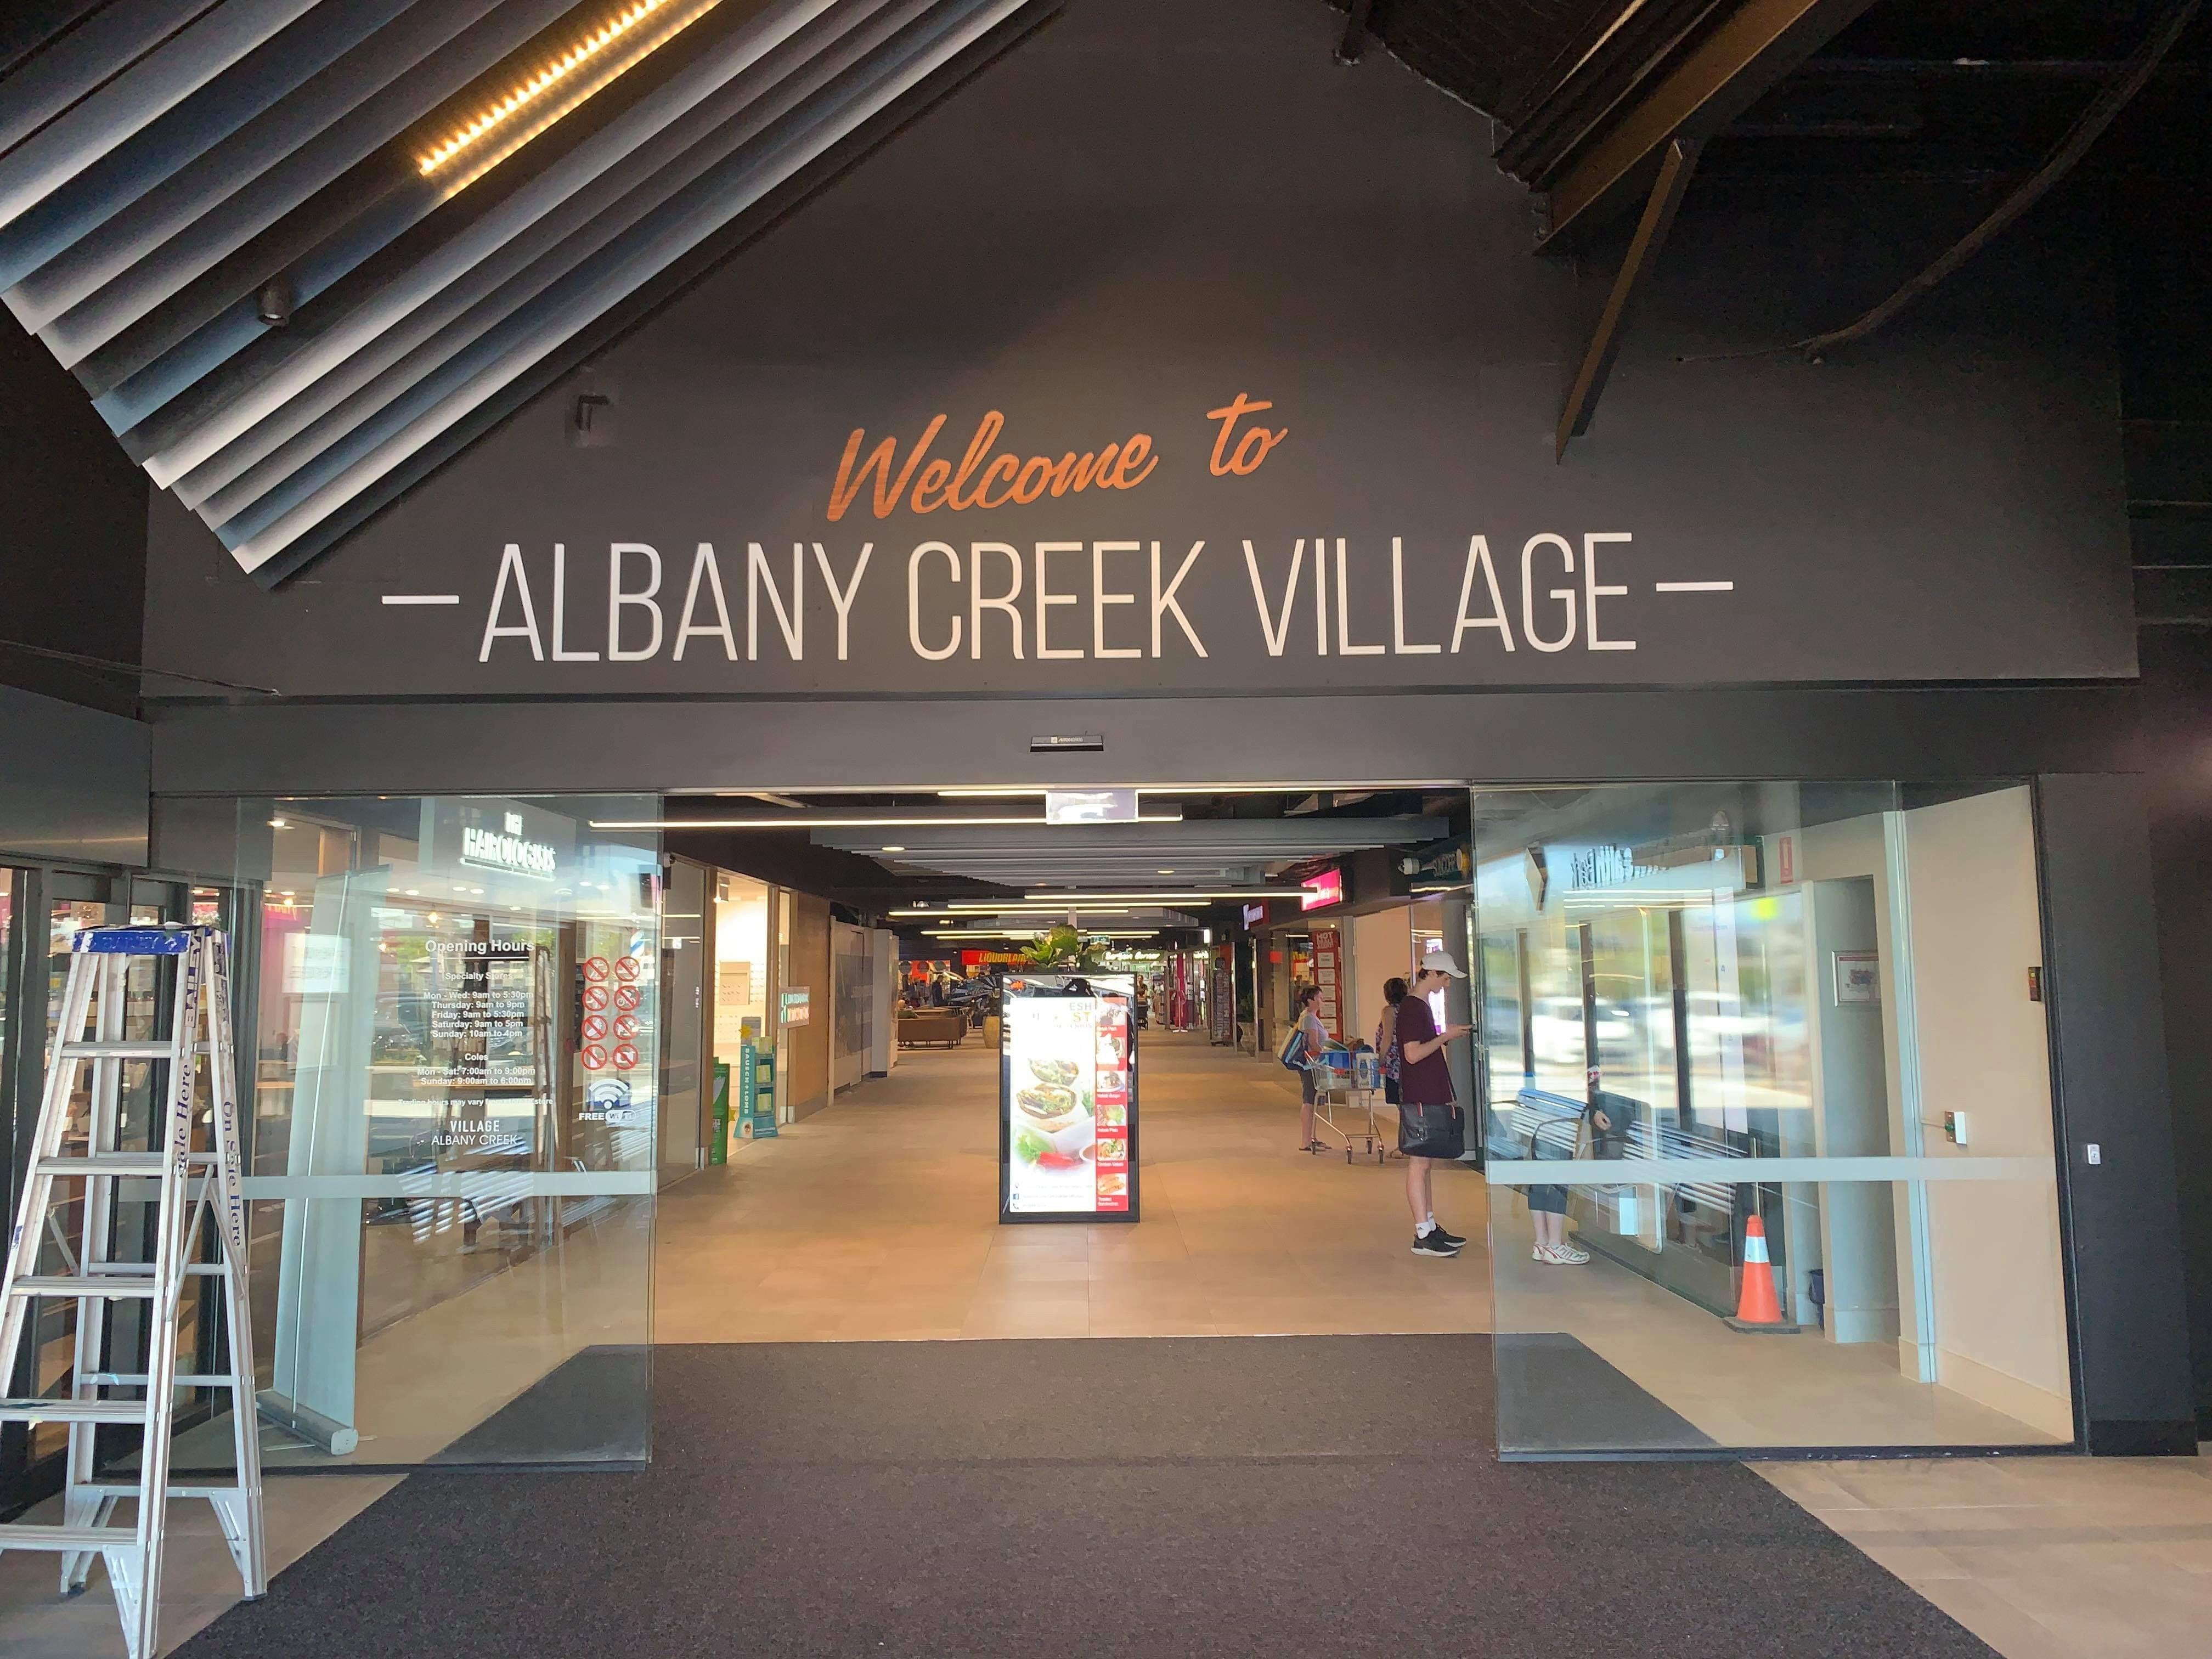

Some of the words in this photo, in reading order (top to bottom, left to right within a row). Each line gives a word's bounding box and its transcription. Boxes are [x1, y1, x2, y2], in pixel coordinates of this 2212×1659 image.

[827, 410, 1158, 521] Welcome
[1207, 393, 1288, 476] to
[478, 543, 874, 663] ALBANY
[908, 540, 1209, 660] CREEK
[1242, 532, 1637, 657] VILLAGE
[425, 939, 487, 955] Opening
[491, 939, 535, 952] Hours
[445, 972, 484, 981] Specialty
[485, 972, 514, 980] Stores
[503, 991, 533, 1001] 5:30pm
[432, 1001, 473, 1011] Thursday:
[506, 1001, 525, 1010] 9pm
[431, 1011, 461, 1020] Friday:
[493, 1011, 524, 1019] 5:30pm
[432, 1020, 472, 1029] Saturday:
[505, 1020, 523, 1029] 5pm
[432, 1030, 467, 1040] Sunday:
[504, 1030, 523, 1039] 4pm
[464, 1053, 489, 1061] Coles
[505, 1068, 535, 1077] 9:00pm
[421, 1077, 455, 1086] Sunday:
[500, 1077, 532, 1086] 6:00pm
[175, 1063, 191, 1120] Here
[578, 1112, 605, 1121] FREE
[450, 1120, 500, 1133] VILLAGE
[431, 1135, 475, 1146] ALBANY
[479, 1134, 518, 1145] CREEK
[223, 1101, 234, 1132] On
[229, 1192, 242, 1247] Here
